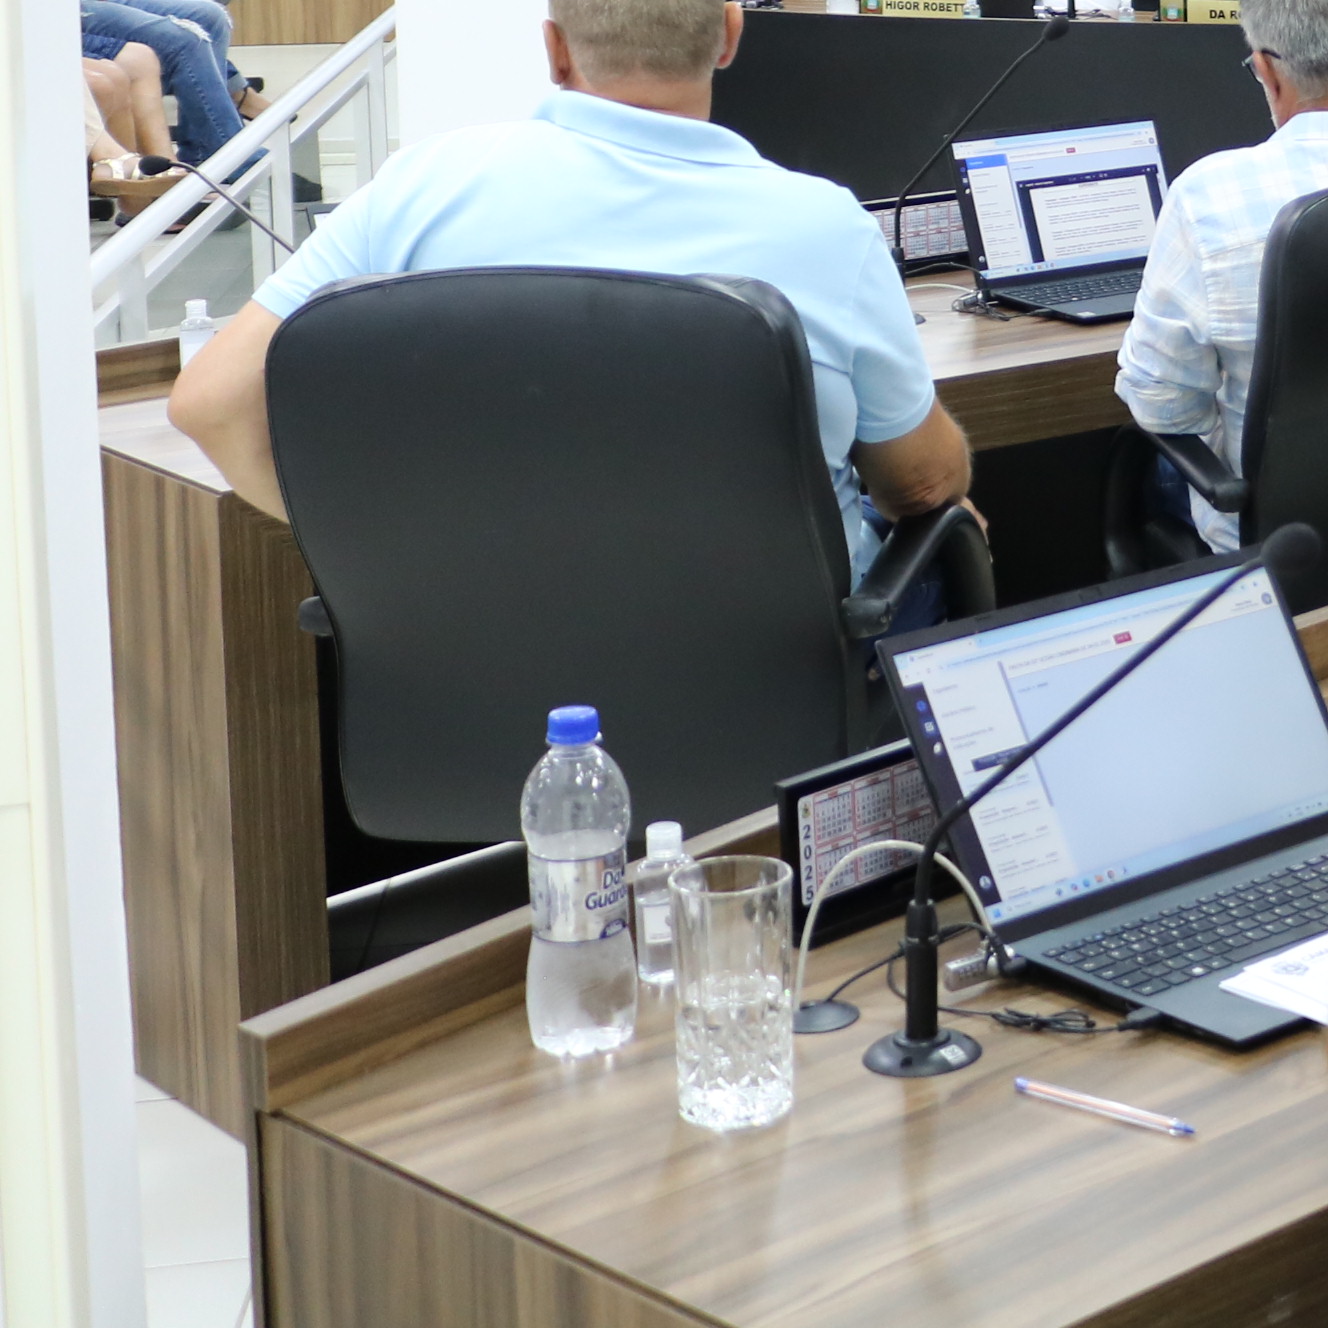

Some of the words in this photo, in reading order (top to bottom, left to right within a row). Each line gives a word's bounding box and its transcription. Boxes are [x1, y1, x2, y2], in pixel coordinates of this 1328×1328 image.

[886, 0, 920, 11] HIGOR
[924, 2, 964, 12] ROBETT
[1210, 10, 1225, 19] DA
[803, 824, 813, 900] 2025
